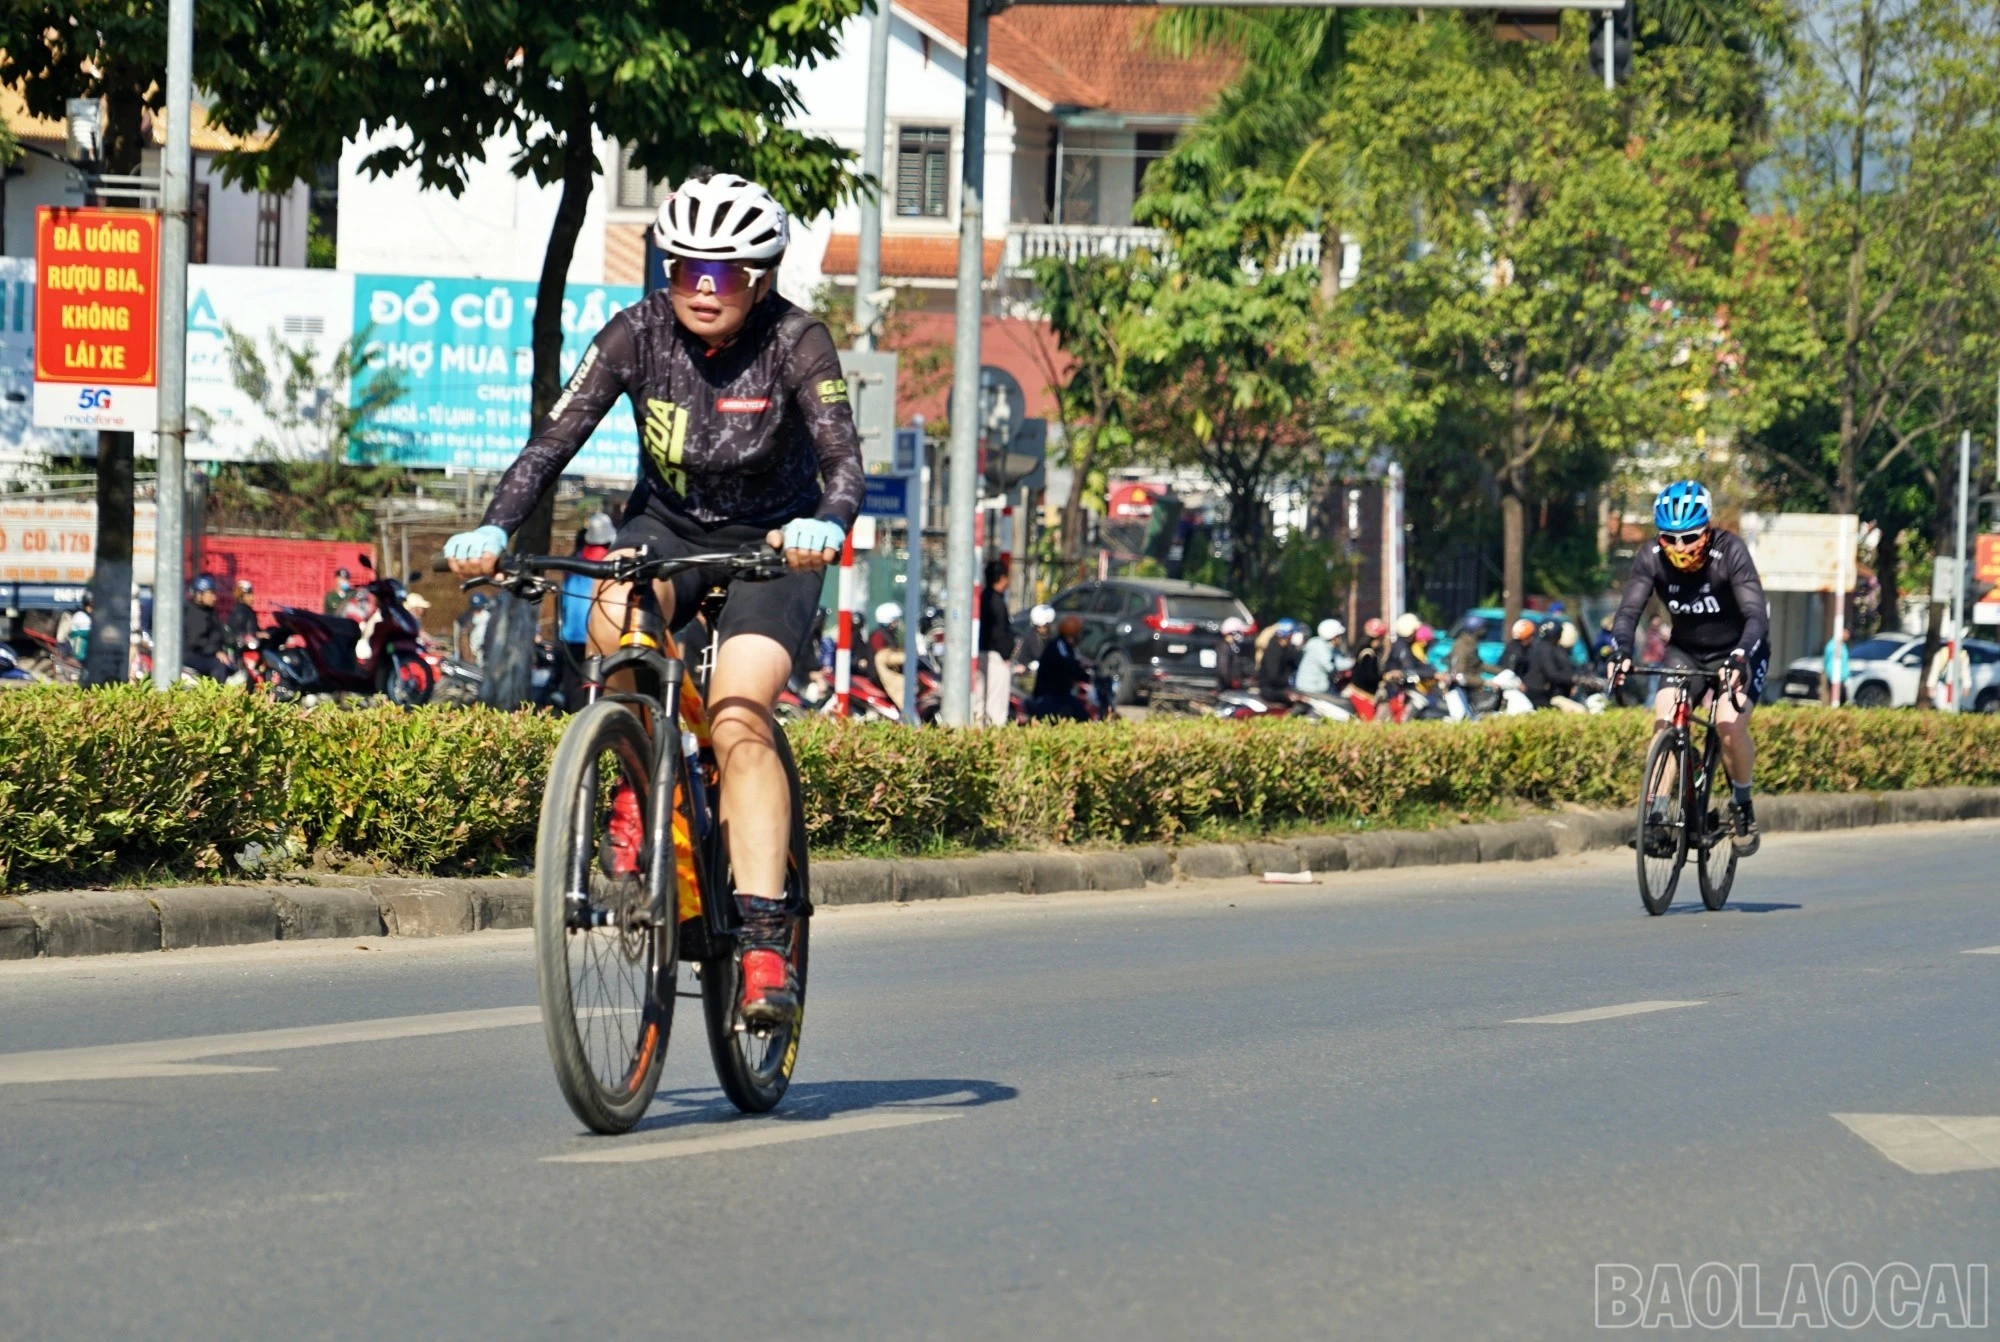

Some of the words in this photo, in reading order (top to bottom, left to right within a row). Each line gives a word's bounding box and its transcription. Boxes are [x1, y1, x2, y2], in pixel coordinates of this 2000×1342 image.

[54, 222, 81, 252] ĐÃ
[85, 220, 140, 254] UỐNG
[47, 263, 101, 295] RƯỢU
[105, 267, 145, 295] BIA,
[62, 300, 131, 331] KHÔNG
[65, 340, 96, 369] LÁI
[100, 345, 127, 369] XE
[363, 339, 434, 379] CHỢ
[440, 343, 509, 375] MUA
[78, 388, 112, 410] 5G
[64, 414, 124, 425] mobifone
[59, 533, 91, 554] 179
